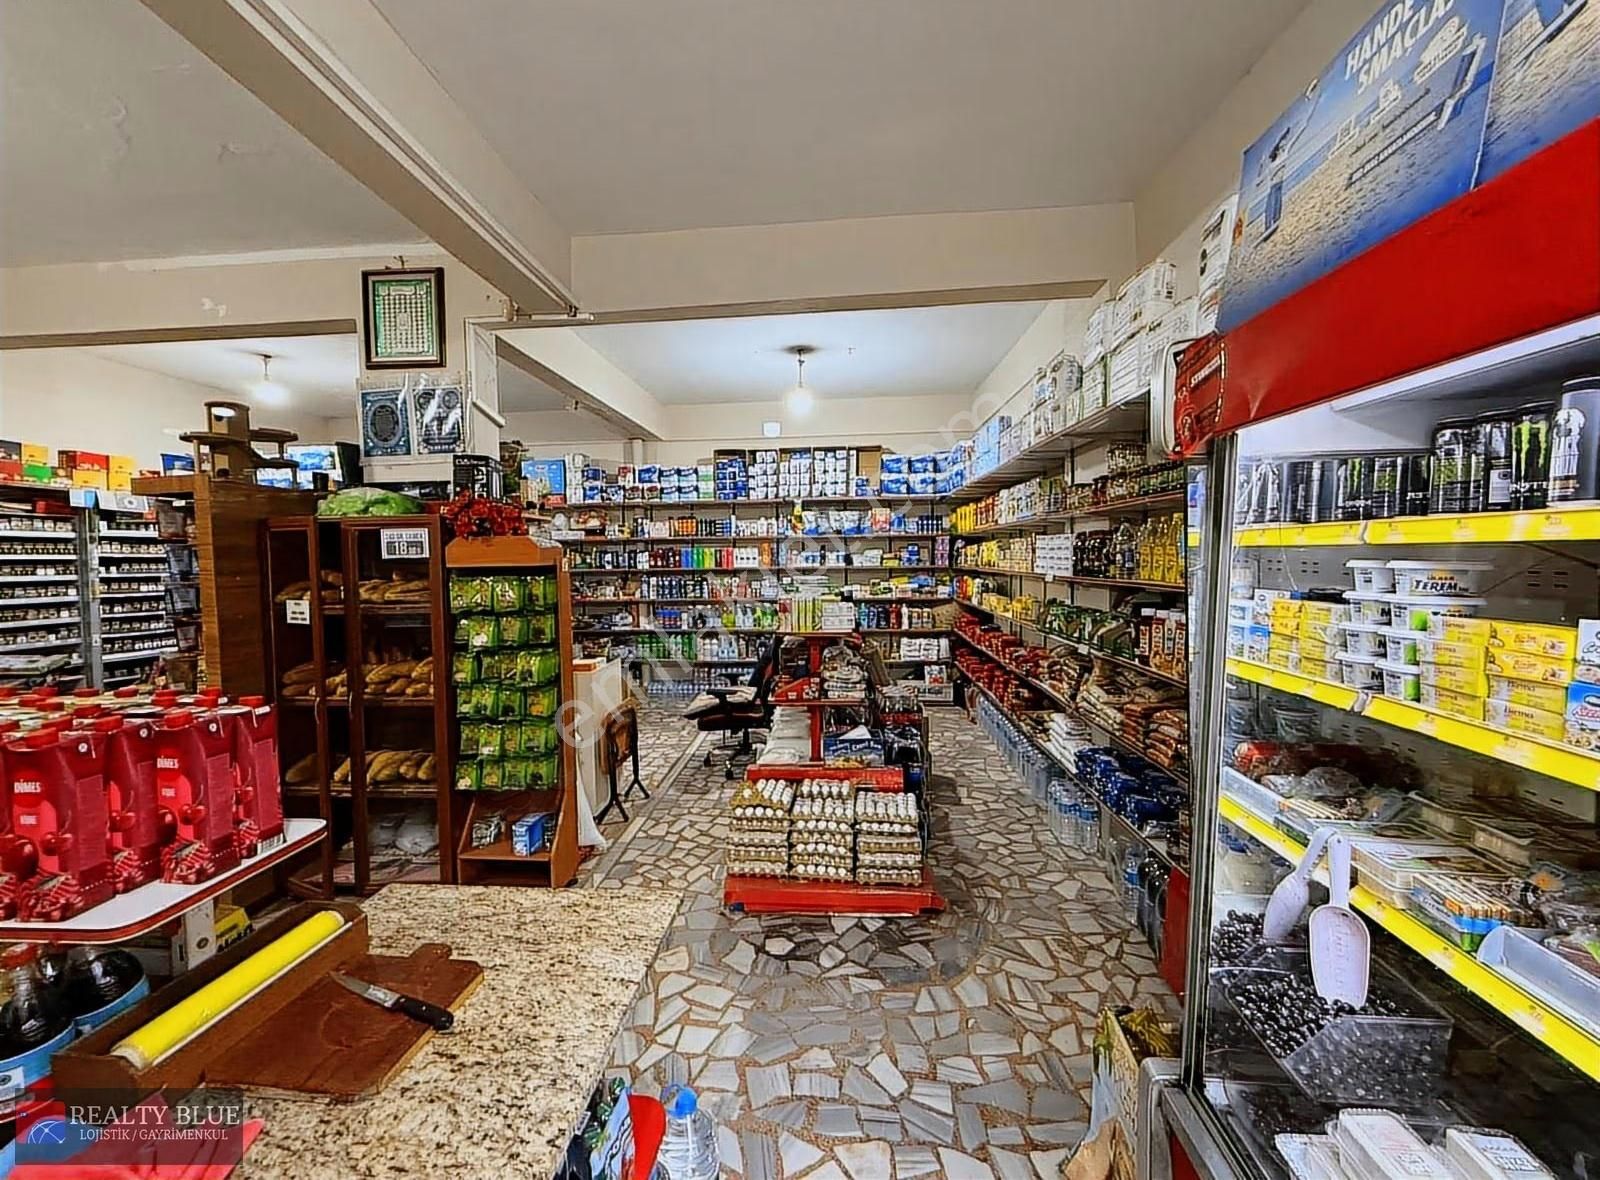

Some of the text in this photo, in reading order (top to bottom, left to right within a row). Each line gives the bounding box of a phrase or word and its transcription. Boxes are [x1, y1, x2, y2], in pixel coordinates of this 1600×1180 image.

[1358, 0, 1454, 94] SMAÇLA
[1414, 579, 1458, 592] TEREM
[157, 755, 179, 769] DİMES
[14, 779, 41, 793] DİMES
